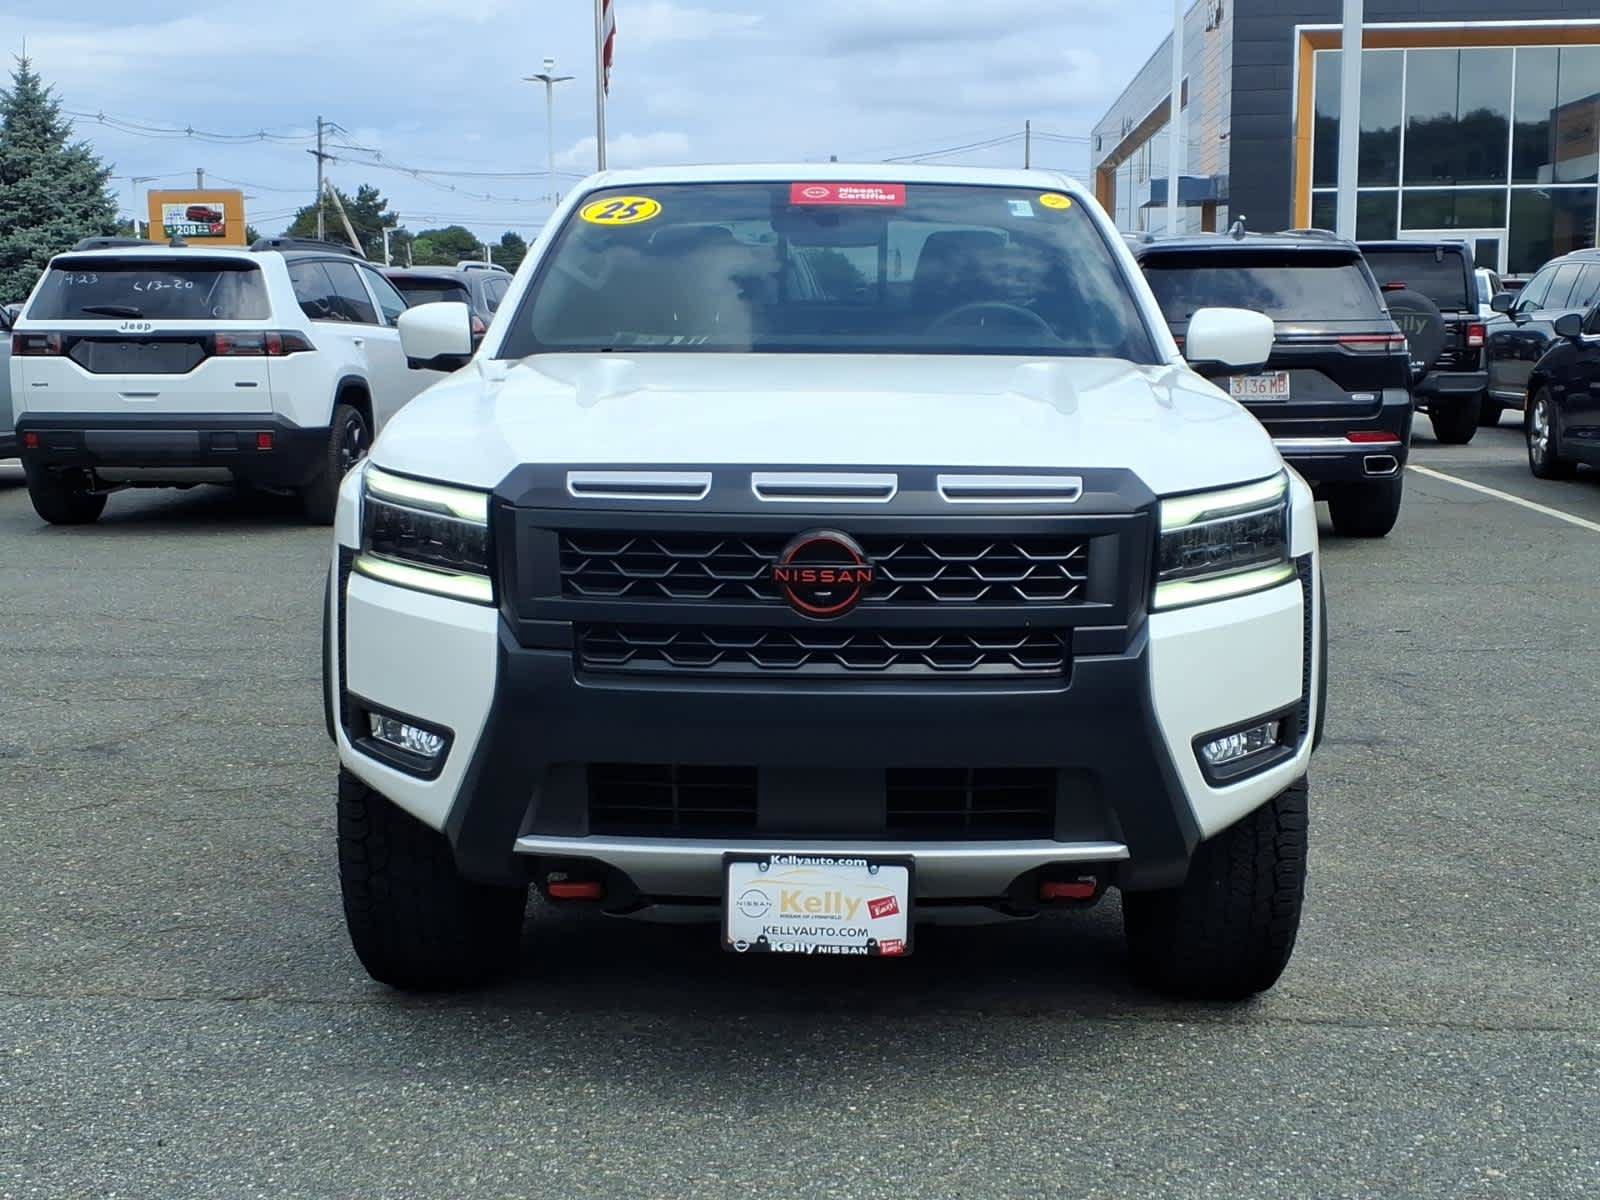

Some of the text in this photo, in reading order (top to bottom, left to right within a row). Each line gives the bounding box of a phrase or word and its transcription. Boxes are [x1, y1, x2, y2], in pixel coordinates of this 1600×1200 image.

[596, 201, 646, 219] 25
[120, 321, 152, 331] Jeep
[1399, 315, 1429, 335] lly
[774, 568, 872, 582] NISSAN
[770, 855, 867, 867] Kellyauto.com
[779, 890, 863, 921] Kelly
[762, 925, 869, 937] KELLYAUTO.COM
[770, 940, 818, 955] Kelly
[818, 945, 869, 955] NISSAN
